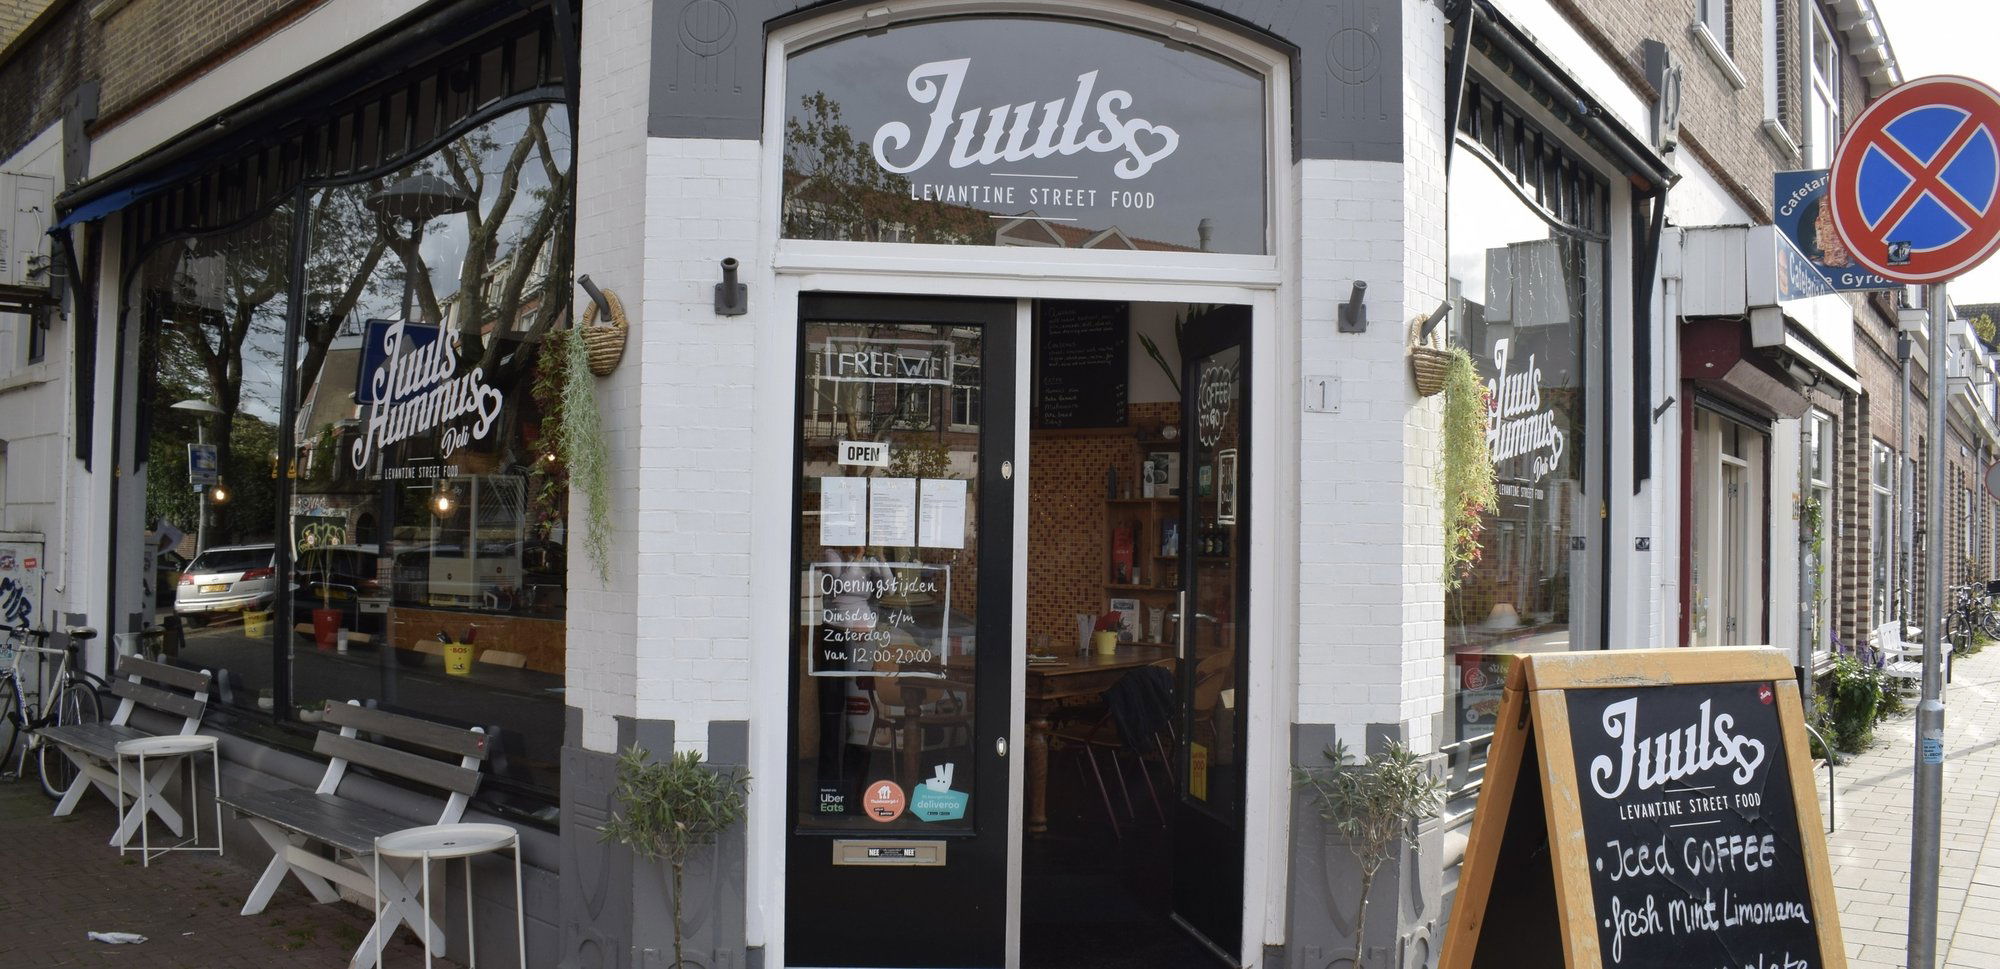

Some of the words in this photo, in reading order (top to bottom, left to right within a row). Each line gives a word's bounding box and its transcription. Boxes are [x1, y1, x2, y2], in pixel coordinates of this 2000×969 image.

[873, 57, 1180, 180] Juuls
[911, 183, 1015, 205] LEVANTINE
[1029, 187, 1097, 208] STREET
[1111, 190, 1155, 210] FOOD
[1780, 172, 1830, 217] Cafetari
[372, 315, 460, 405] Juuls
[838, 351, 897, 377] FREE
[1488, 338, 1542, 418] Juuls
[1201, 382, 1229, 410] COFFEE
[1318, 380, 1326, 409] 1
[352, 367, 503, 471] Hummus
[1200, 414, 1210, 428] TO
[1210, 408, 1221, 430] GO
[441, 425, 471, 460] Deli
[847, 446, 880, 462] OPEN
[1484, 409, 1564, 472] Hummus
[384, 467, 416, 480] LEVANTINE
[418, 465, 440, 479] STREET
[443, 464, 459, 478] FOOD
[820, 573, 938, 599] Openingstijden
[823, 628, 892, 648] Zaterdag
[1590, 696, 1766, 800] Juuls
[820, 793, 845, 803] Uber
[820, 803, 845, 813] Eats
[917, 799, 960, 809] deliveroo
[1619, 799, 1684, 821] LEVANTINE
[1688, 795, 1729, 814] STREET
[1735, 792, 1762, 809] FOOD
[868, 848, 880, 857] NEE
[903, 848, 915, 857] NEE
[1683, 833, 1777, 878] COFFEE
[1723, 887, 1811, 928] Limonana
